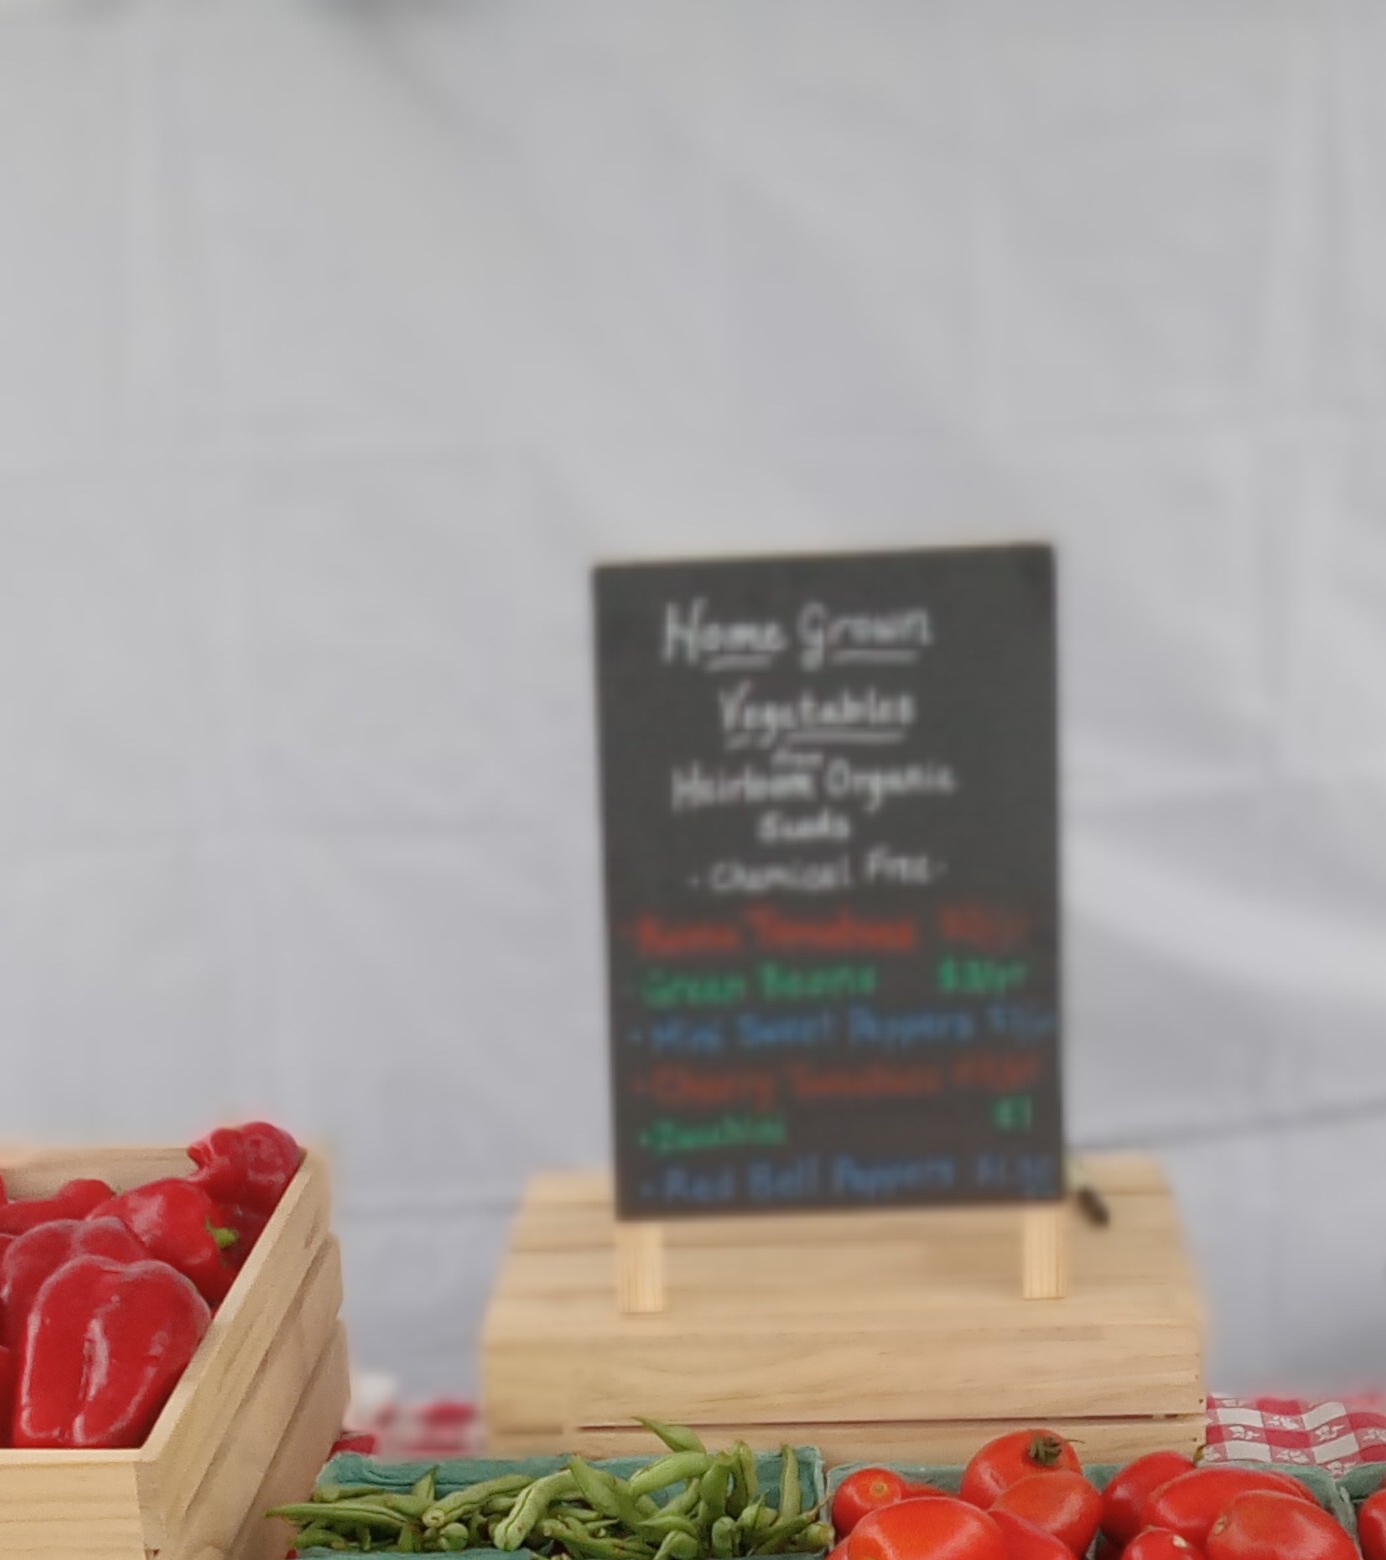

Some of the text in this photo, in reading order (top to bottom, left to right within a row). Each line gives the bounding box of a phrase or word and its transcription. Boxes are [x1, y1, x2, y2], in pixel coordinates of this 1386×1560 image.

[663, 597, 932, 669] Home Grown
[719, 679, 914, 746] Vegetables
